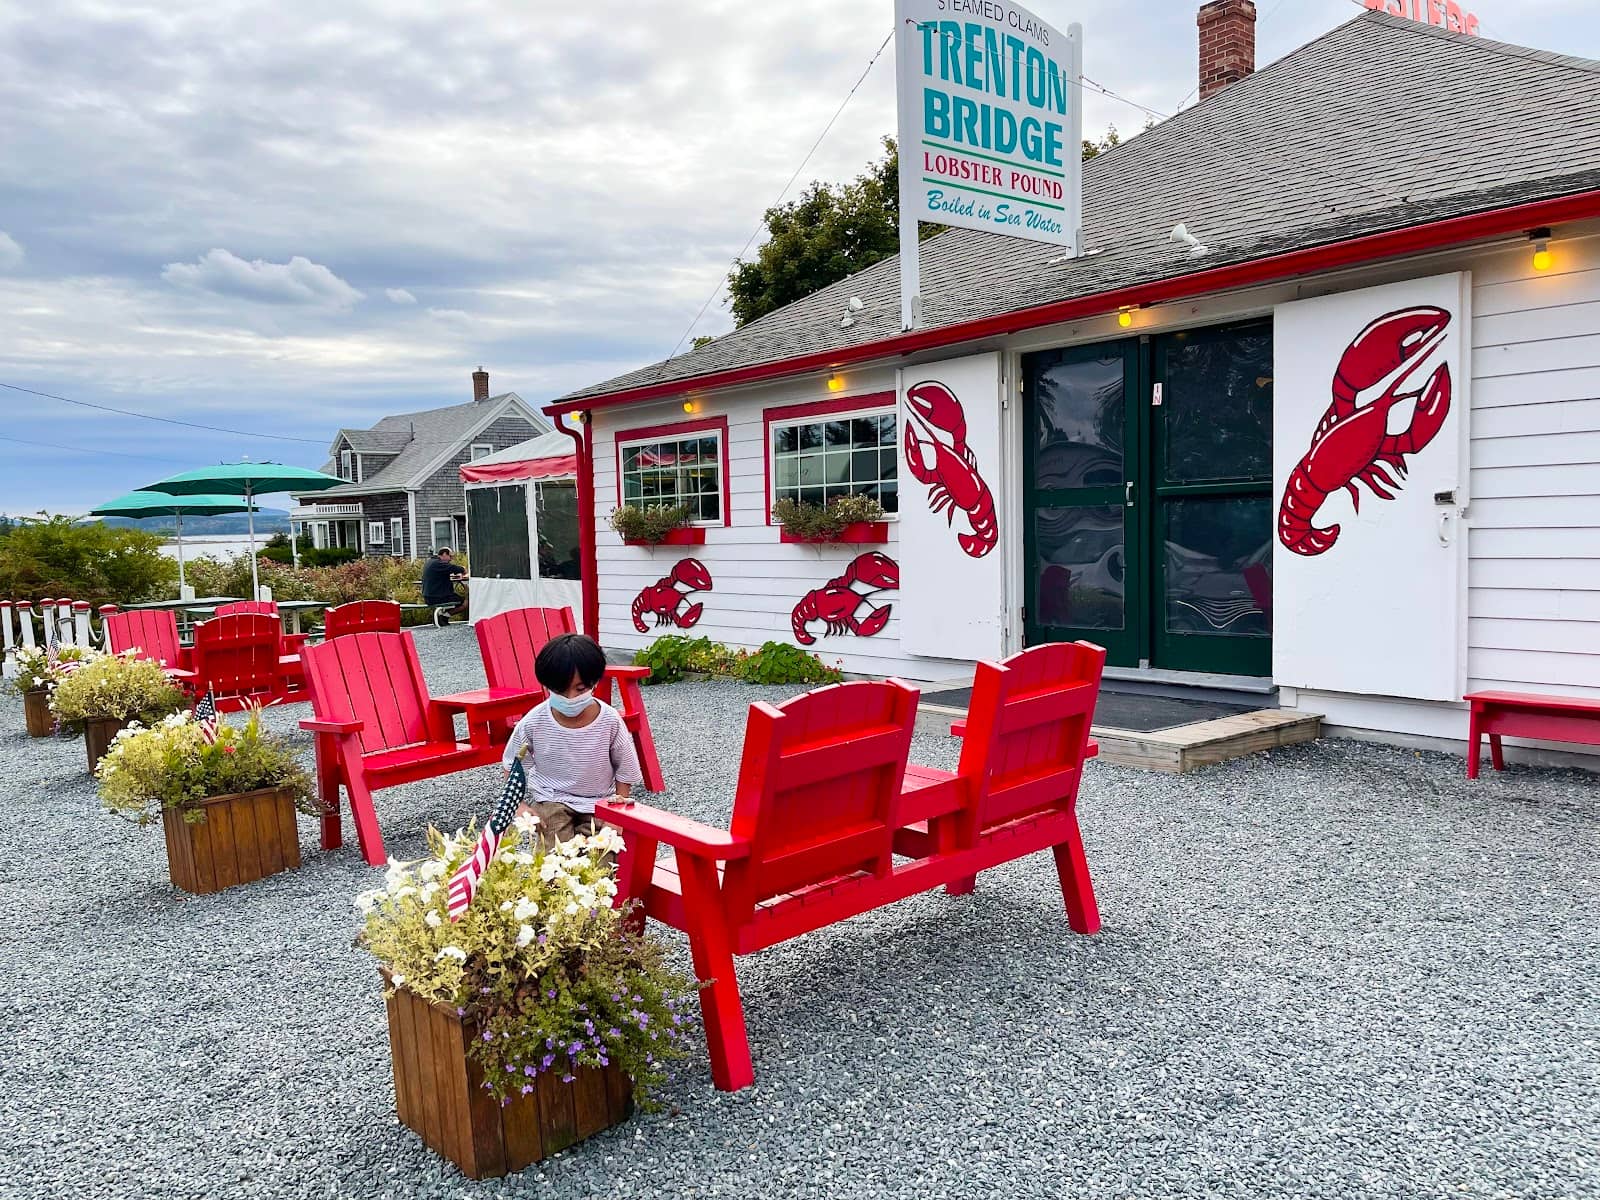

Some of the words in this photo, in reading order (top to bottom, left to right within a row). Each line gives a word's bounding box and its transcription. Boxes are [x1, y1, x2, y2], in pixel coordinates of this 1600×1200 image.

[938, 0, 1004, 22] STEAMED
[1008, 10, 1049, 46] CLAMS
[917, 20, 1067, 116] TRENTON
[923, 87, 1063, 168] BRIDGE
[924, 151, 1003, 187] LOBSTER
[1011, 171, 1063, 200] POUND
[926, 189, 976, 217] Boiled
[978, 204, 991, 220] in
[994, 203, 1022, 226] Sea
[1025, 209, 1063, 234] Water
